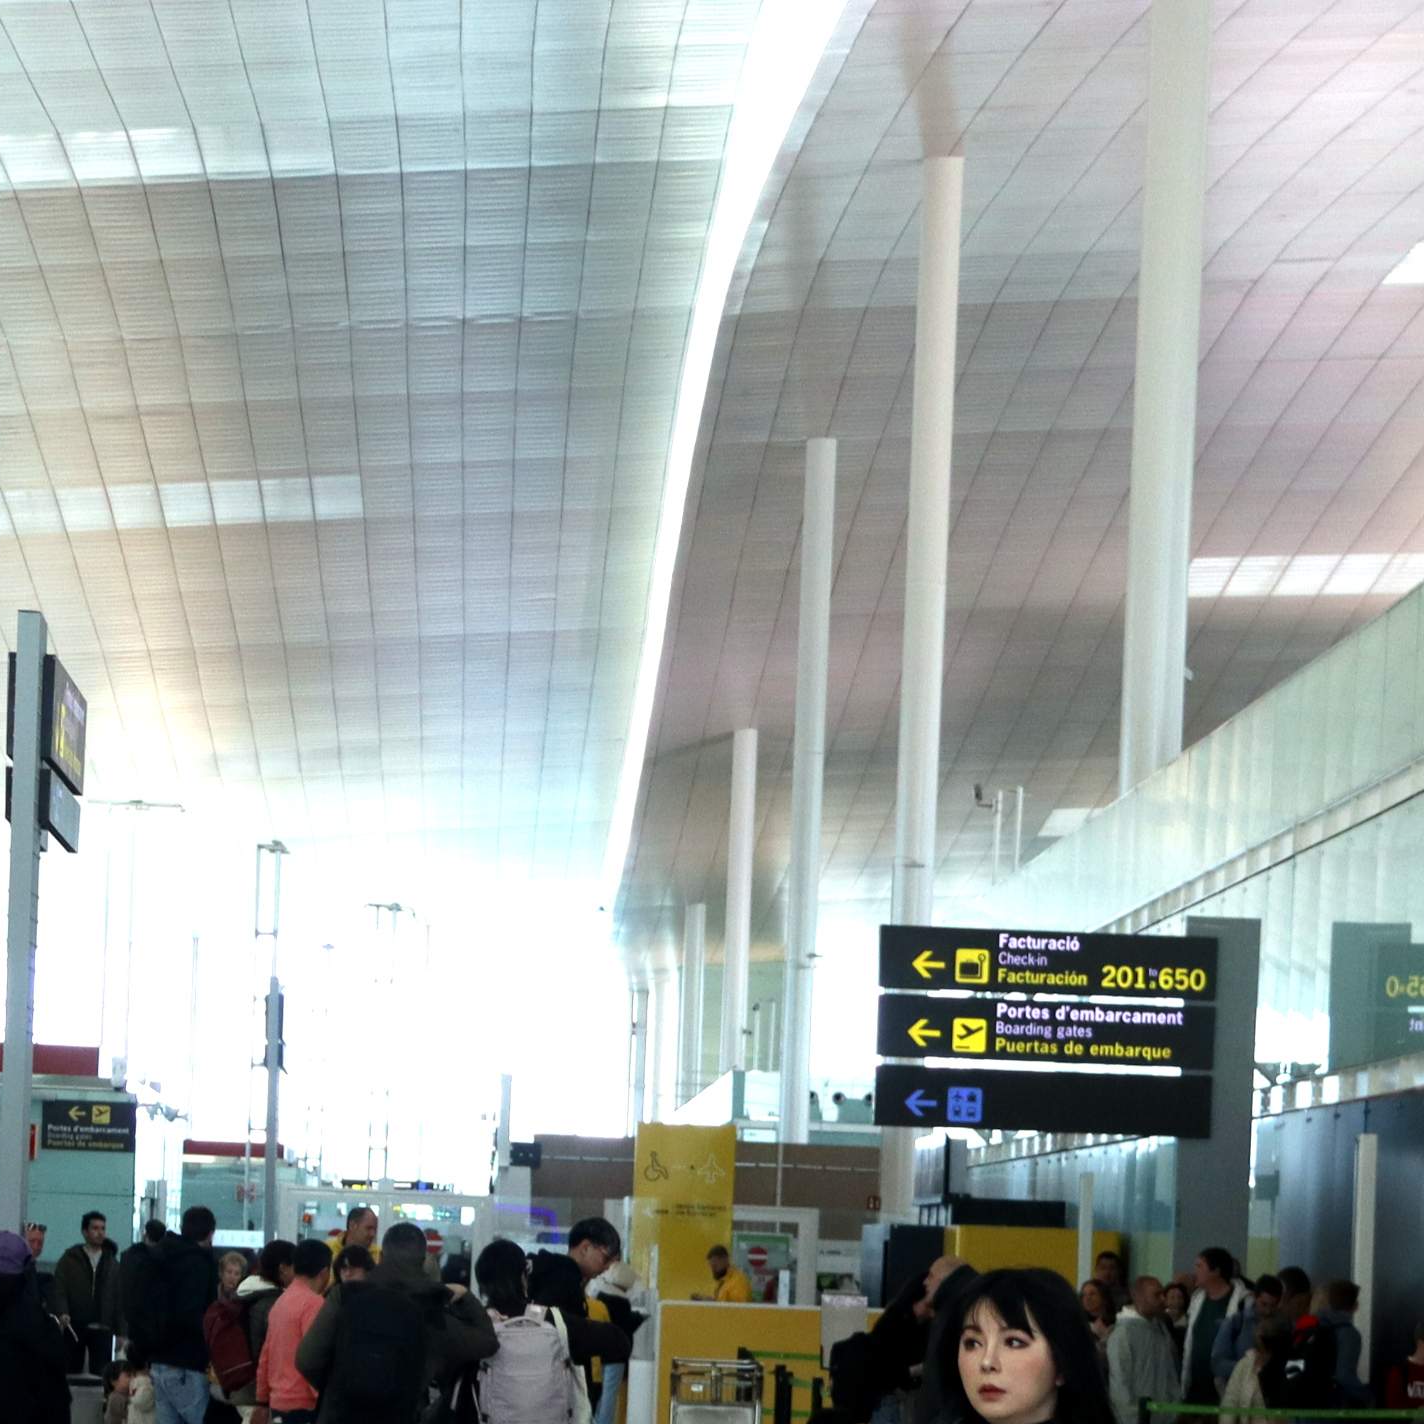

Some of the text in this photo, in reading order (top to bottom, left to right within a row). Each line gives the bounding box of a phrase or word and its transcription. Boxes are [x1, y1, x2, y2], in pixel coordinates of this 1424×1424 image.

[999, 933, 1080, 951] Facturació
[998, 951, 1048, 966] Check-in
[998, 968, 1088, 987] Facturación
[1101, 965, 1146, 989] 201
[1158, 967, 1206, 991] 650
[996, 1003, 1183, 1025] Portes d'embarcament
[996, 1021, 1093, 1039] Boarding gates
[995, 1037, 1172, 1060] Puertas de embarque
